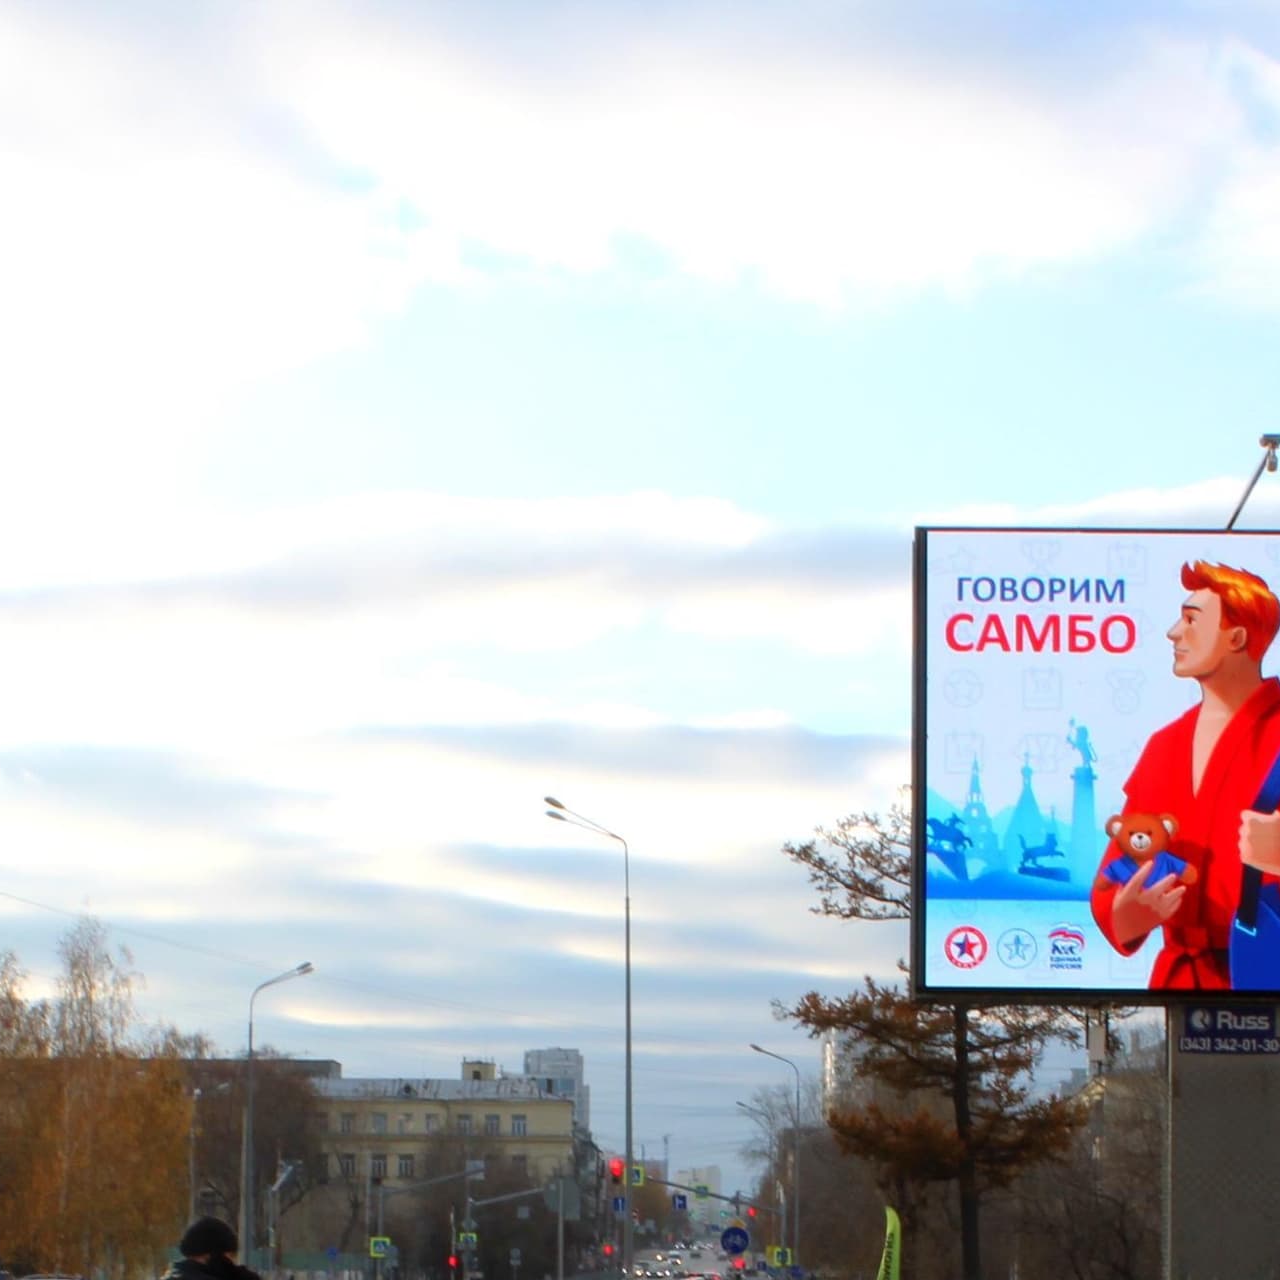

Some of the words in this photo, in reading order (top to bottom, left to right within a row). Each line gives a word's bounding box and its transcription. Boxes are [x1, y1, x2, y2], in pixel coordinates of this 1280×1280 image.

[957, 577, 1125, 603] ГОВОРИМ
[945, 613, 1136, 653] САМБО
[1217, 1010, 1270, 1030] Russ
[1180, 1037, 1211, 1052] (343)
